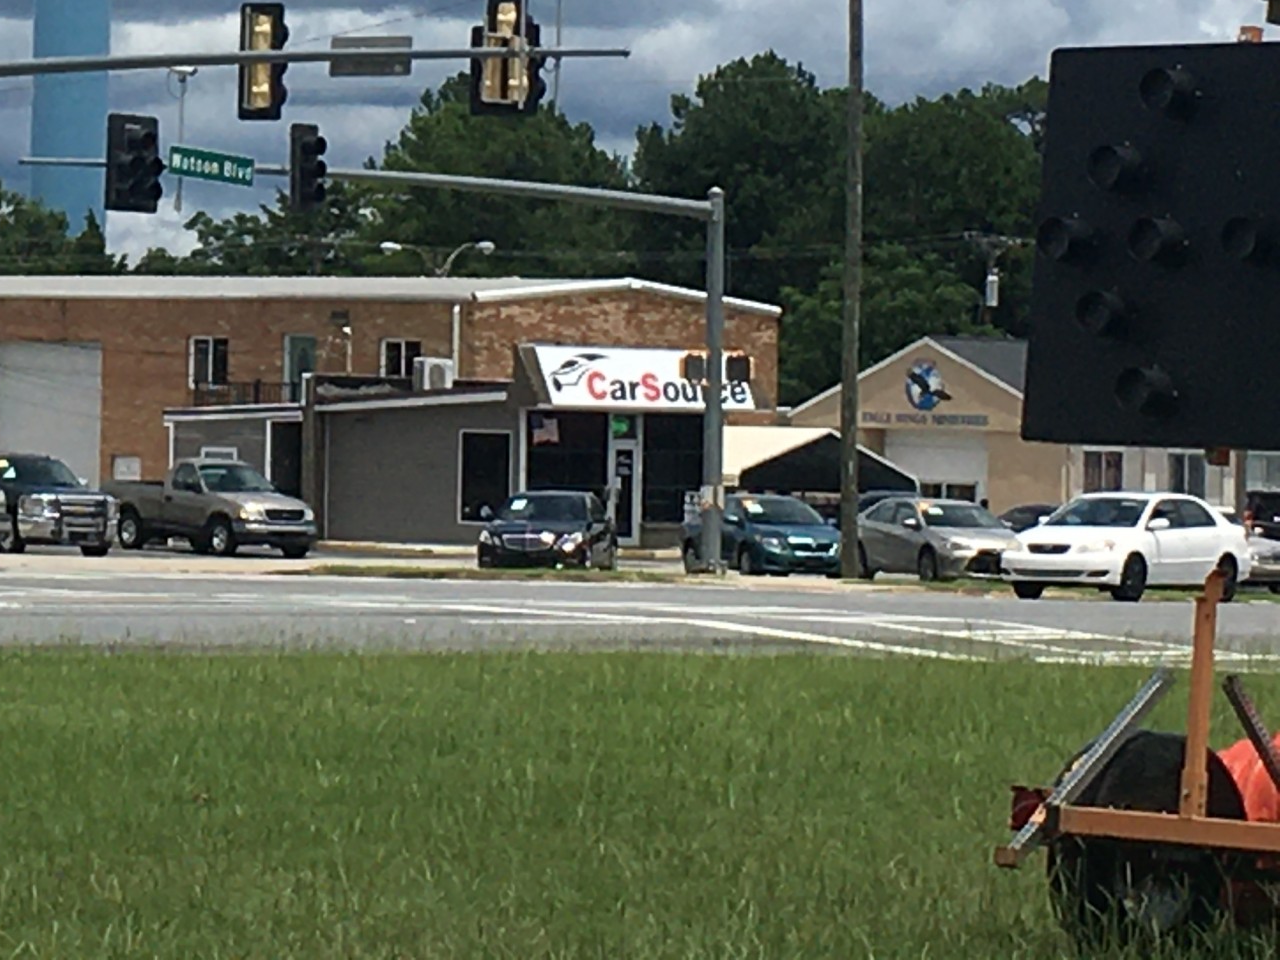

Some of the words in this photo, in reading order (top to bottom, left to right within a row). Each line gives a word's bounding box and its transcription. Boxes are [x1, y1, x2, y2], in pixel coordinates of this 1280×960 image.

[172, 153, 220, 175] Watson
[223, 160, 252, 181] Blvd
[586, 370, 748, 404] CarSouce
